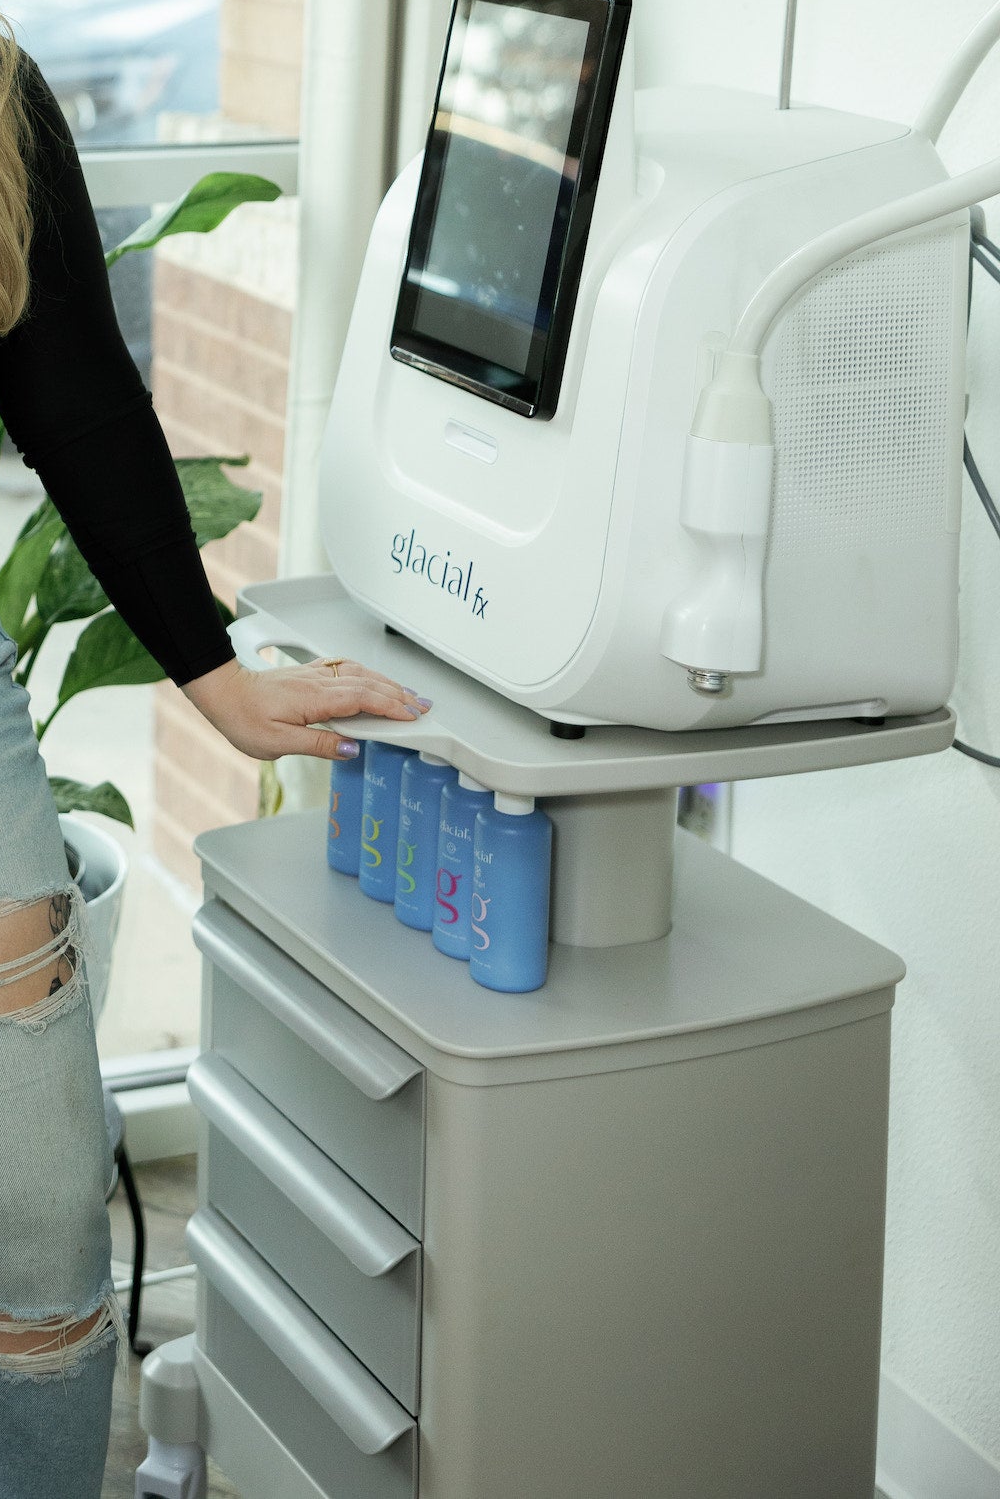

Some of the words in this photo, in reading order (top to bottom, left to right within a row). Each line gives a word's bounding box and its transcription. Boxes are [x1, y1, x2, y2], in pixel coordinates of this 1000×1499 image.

[390, 528, 474, 602] glacial
[471, 587, 489, 620] fx
[361, 813, 384, 868] g
[397, 838, 418, 894] g
[436, 867, 463, 925] g
[471, 892, 492, 951] g
